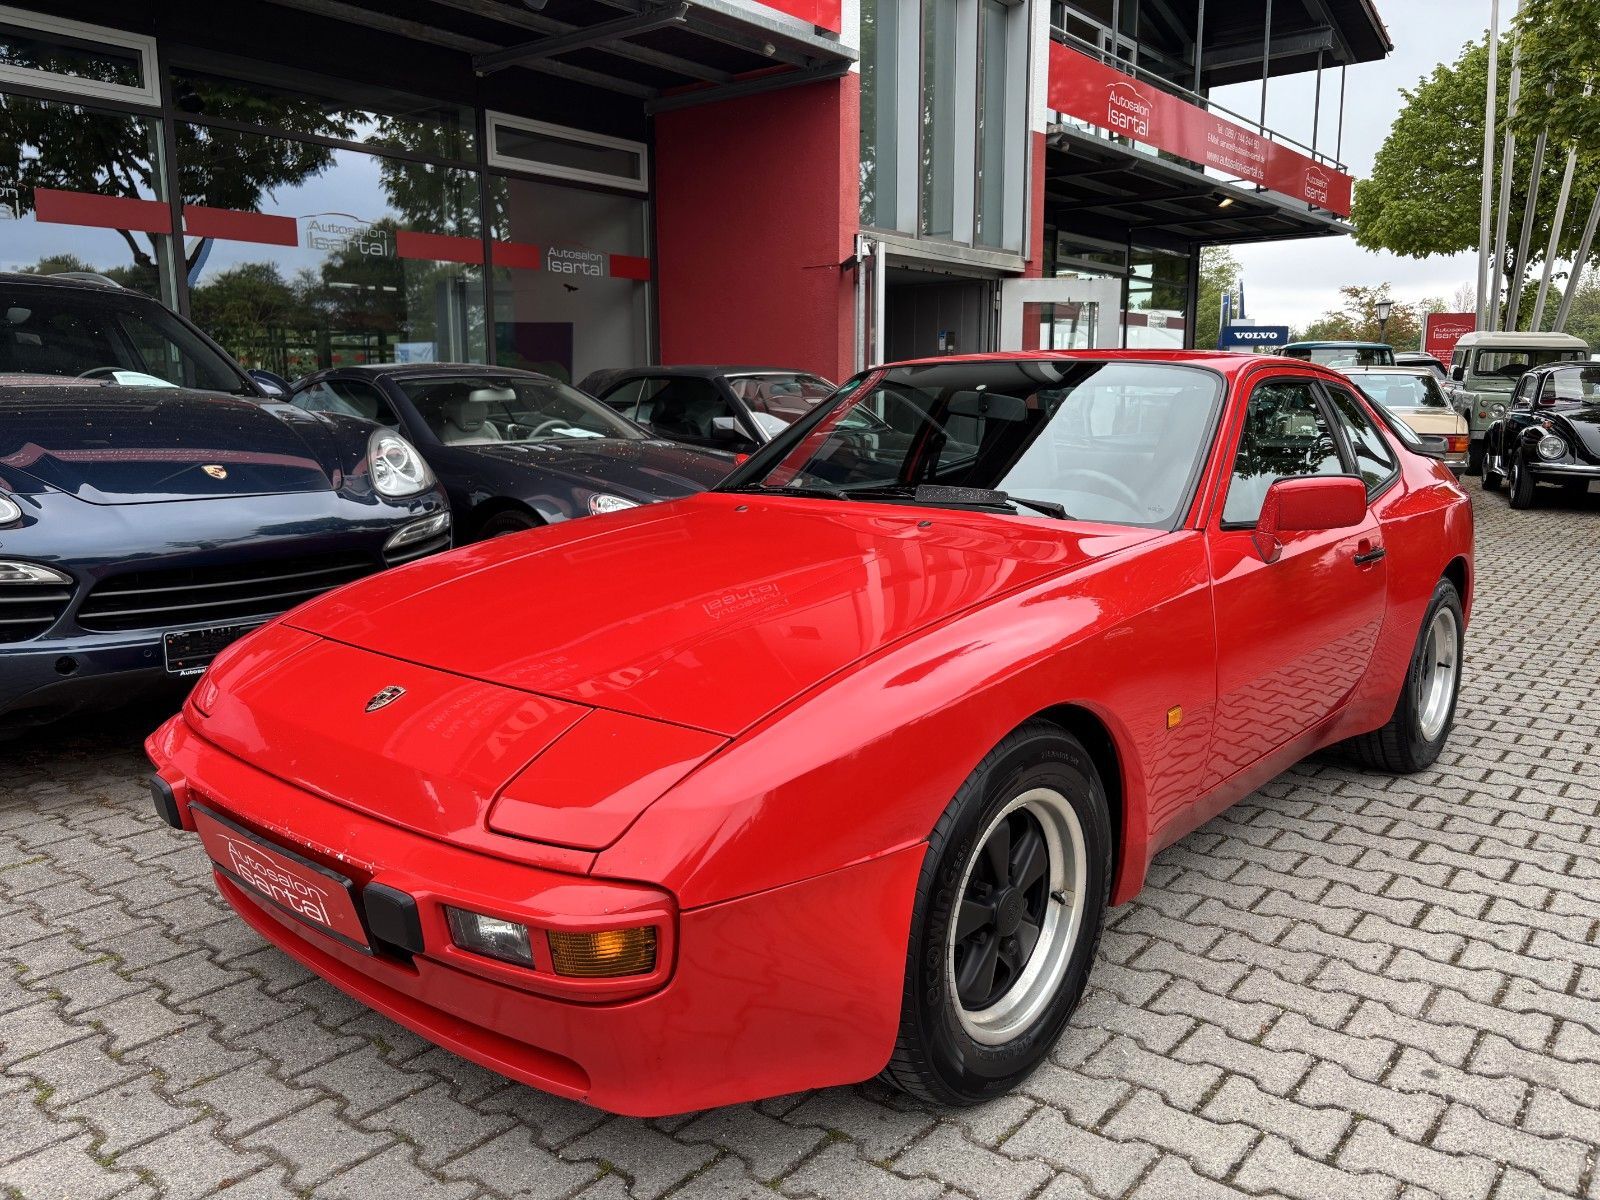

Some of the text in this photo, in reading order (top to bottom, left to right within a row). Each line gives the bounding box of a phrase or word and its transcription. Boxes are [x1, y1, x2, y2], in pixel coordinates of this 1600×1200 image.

[1109, 90, 1150, 117] Autosalon
[1108, 102, 1149, 137] Isartal
[1306, 172, 1328, 189] Autosalon
[1305, 182, 1328, 204] Isartal
[307, 220, 387, 239] Autosalon
[548, 246, 603, 261] Autosalon
[547, 256, 603, 277] Isartal
[1233, 331, 1278, 339] VOLVO
[228, 841, 321, 900] Autosalon
[230, 853, 331, 926] Isartal
